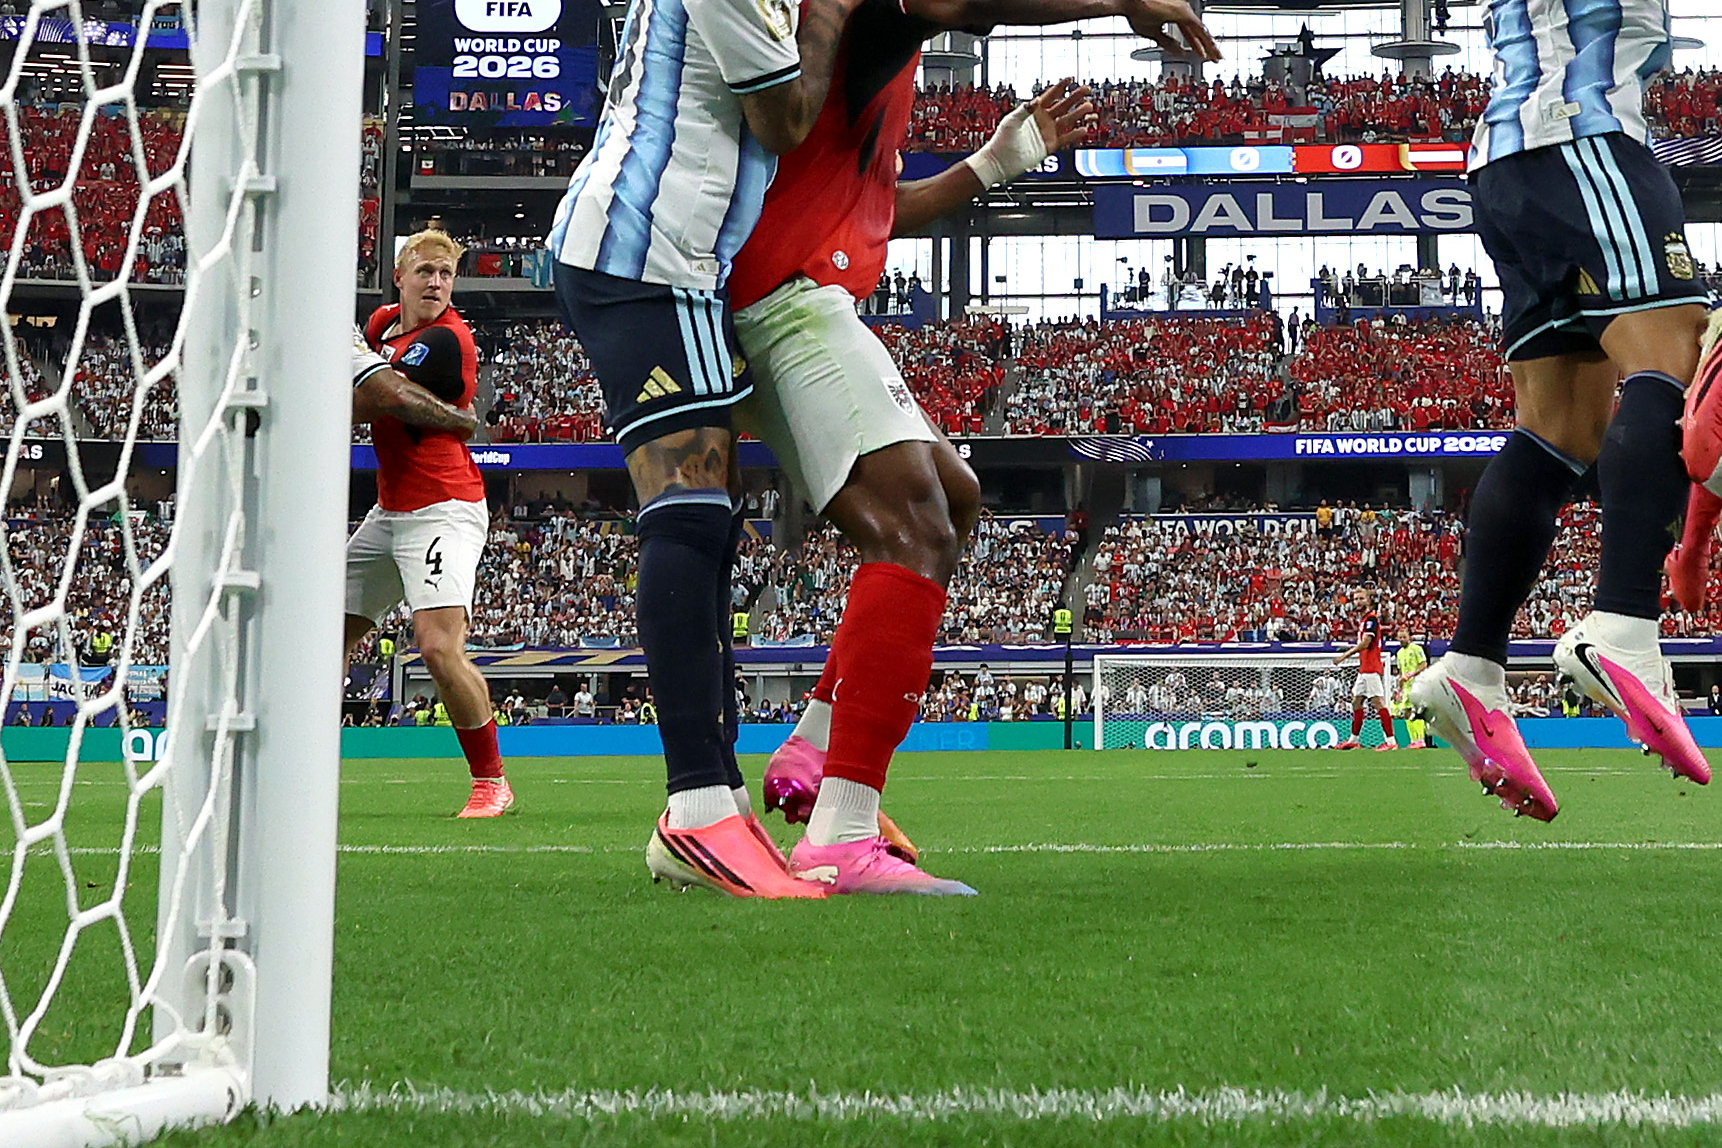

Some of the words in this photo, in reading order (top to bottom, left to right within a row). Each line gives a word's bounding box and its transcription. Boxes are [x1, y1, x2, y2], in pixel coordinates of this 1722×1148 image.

[486, 2, 533, 17] FIFA
[454, 38, 521, 53] WORLD
[523, 38, 561, 52] CUP
[453, 55, 560, 78] 2026
[450, 91, 562, 111] DALLAS
[1133, 189, 1474, 233] DALLAS
[1296, 439, 1335, 454] FIFA
[1336, 438, 1402, 453] WORLD
[1404, 437, 1442, 452] CUP
[425, 536, 443, 575] 4
[1145, 722, 1338, 750] aramco
